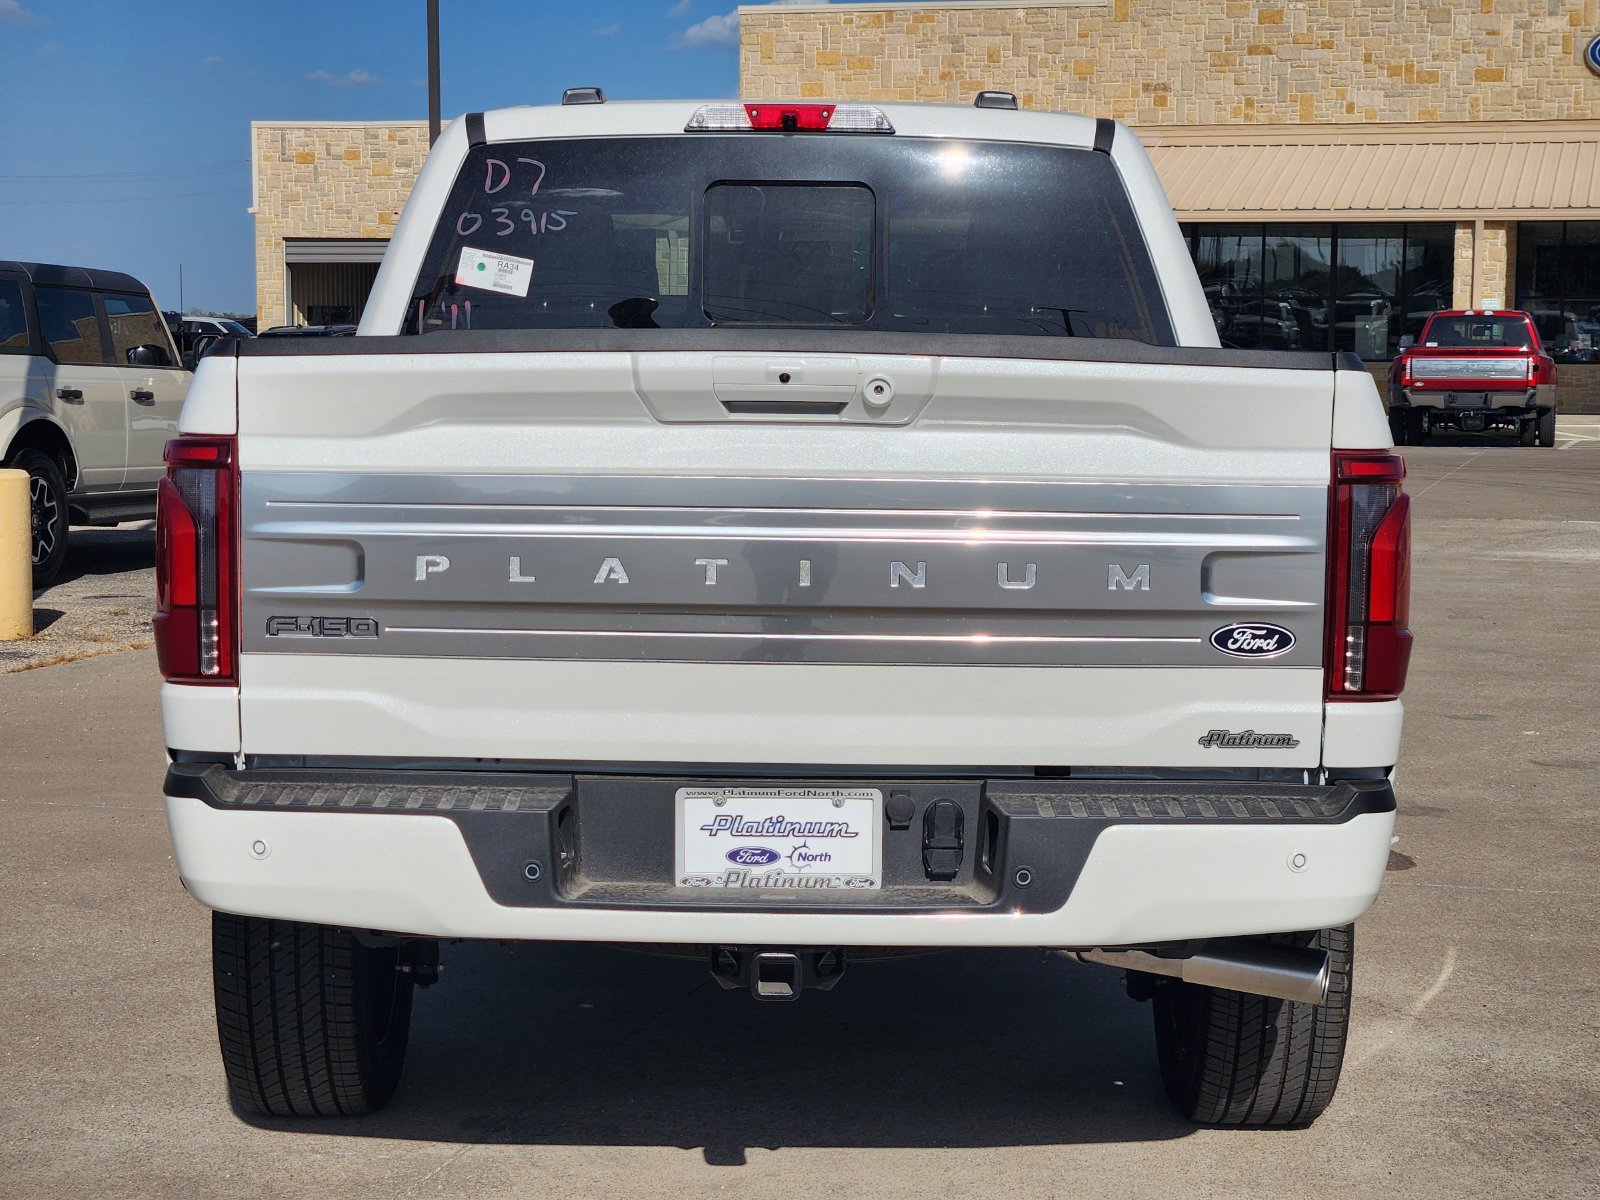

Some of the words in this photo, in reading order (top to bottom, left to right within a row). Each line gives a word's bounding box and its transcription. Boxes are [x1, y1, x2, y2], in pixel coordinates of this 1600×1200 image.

[456, 208, 578, 236] 03915
[497, 261, 519, 271] RA34
[415, 555, 1152, 591] PLATINUM
[265, 615, 379, 639] F-150
[1226, 628, 1281, 651] Ford
[1198, 729, 1300, 748] Platinum
[685, 789, 873, 797] www.PlatinumFordNorth.com
[700, 814, 859, 838] Platinum
[735, 848, 770, 864] Ford
[797, 851, 832, 863] North
[722, 870, 841, 889] Platinum
